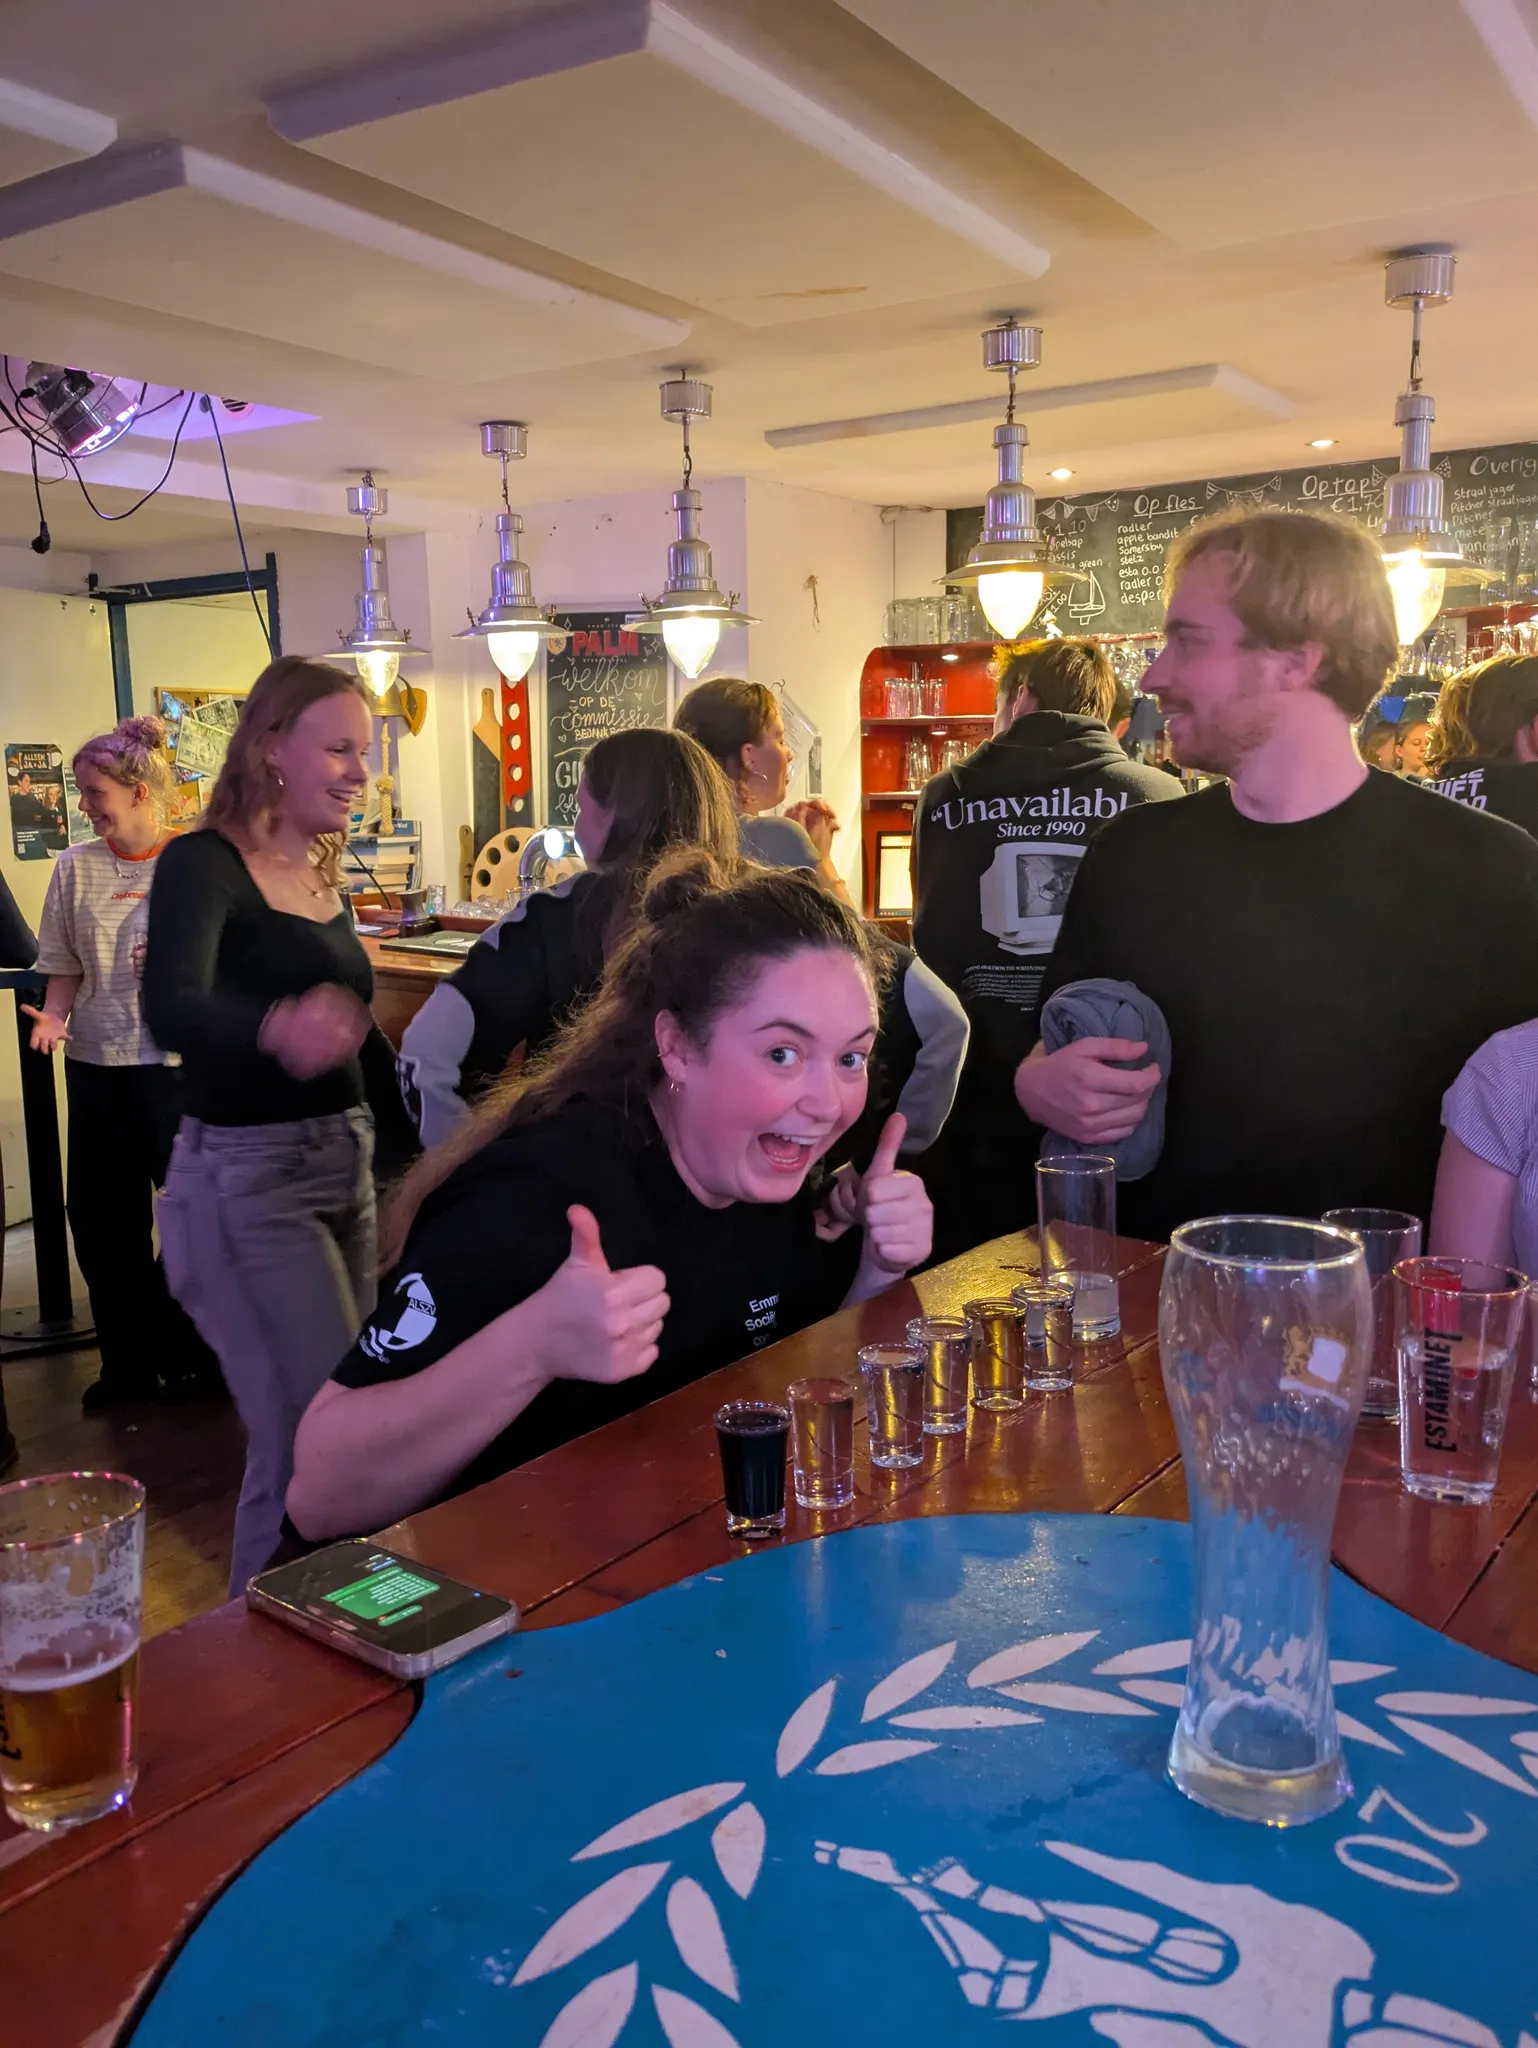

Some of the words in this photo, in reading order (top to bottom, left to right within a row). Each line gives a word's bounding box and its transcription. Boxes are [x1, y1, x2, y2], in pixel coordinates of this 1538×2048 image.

[1133, 494, 1160, 518] Op
[1165, 494, 1197, 511] fles
[1117, 521, 1153, 534] radler
[1454, 526, 1486, 540] mete
[1117, 533, 1144, 548] apple
[1146, 527, 1179, 541] bandit
[1141, 565, 1160, 576] 0.0
[1120, 577, 1151, 591] radler
[572, 630, 640, 656] PALM
[579, 696, 594, 707] OP
[600, 696, 616, 708] DE
[930, 786, 1129, 831] “Unavailabl
[996, 822, 1041, 838] Since
[1043, 821, 1086, 837] 1990
[1424, 1327, 1463, 1453] ESTAMINET
